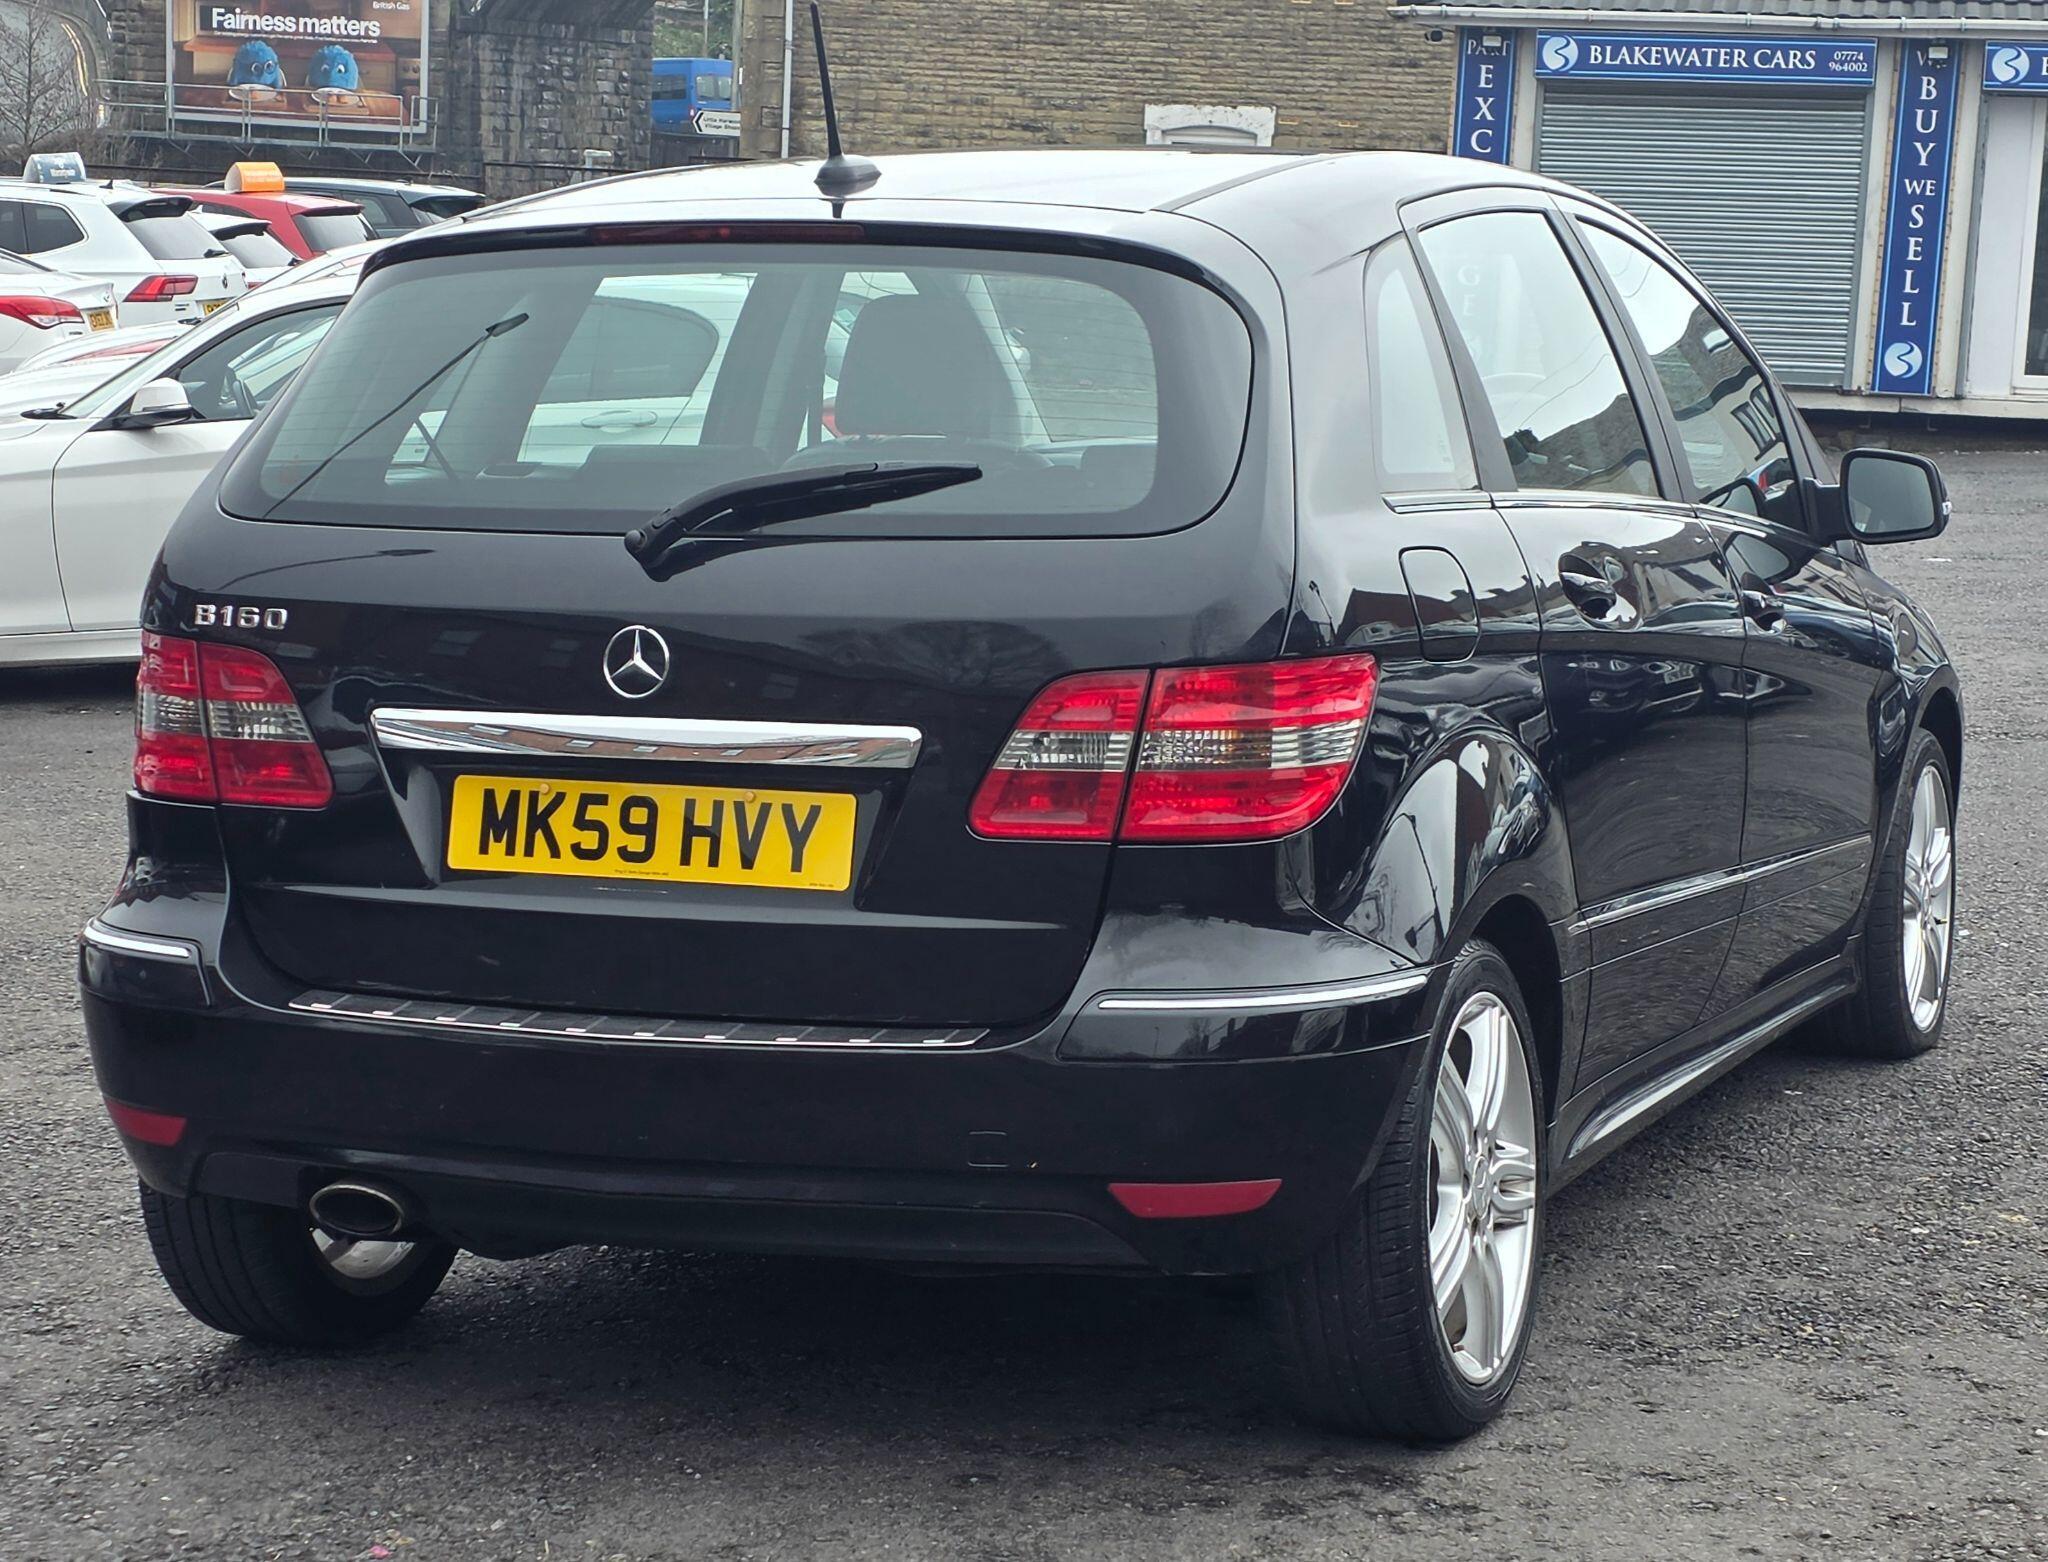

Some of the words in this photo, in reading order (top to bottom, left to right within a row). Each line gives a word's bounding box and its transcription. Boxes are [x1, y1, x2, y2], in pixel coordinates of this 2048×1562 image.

[372, 1, 396, 10] British
[396, 2, 410, 10] Gas
[212, 8, 296, 32] Fairness
[299, 16, 381, 37] matters
[1589, 45, 1750, 68] BLAKEWATER
[1753, 49, 1816, 69] CARS
[1828, 61, 1868, 73] 964002
[1833, 50, 1864, 61] 07774
[1913, 76, 1939, 166] BUY
[1904, 179, 1937, 196] WE
[1900, 204, 1925, 326] SELL
[194, 604, 288, 630] B160
[478, 787, 660, 864] MK59
[679, 798, 823, 874] HVY
